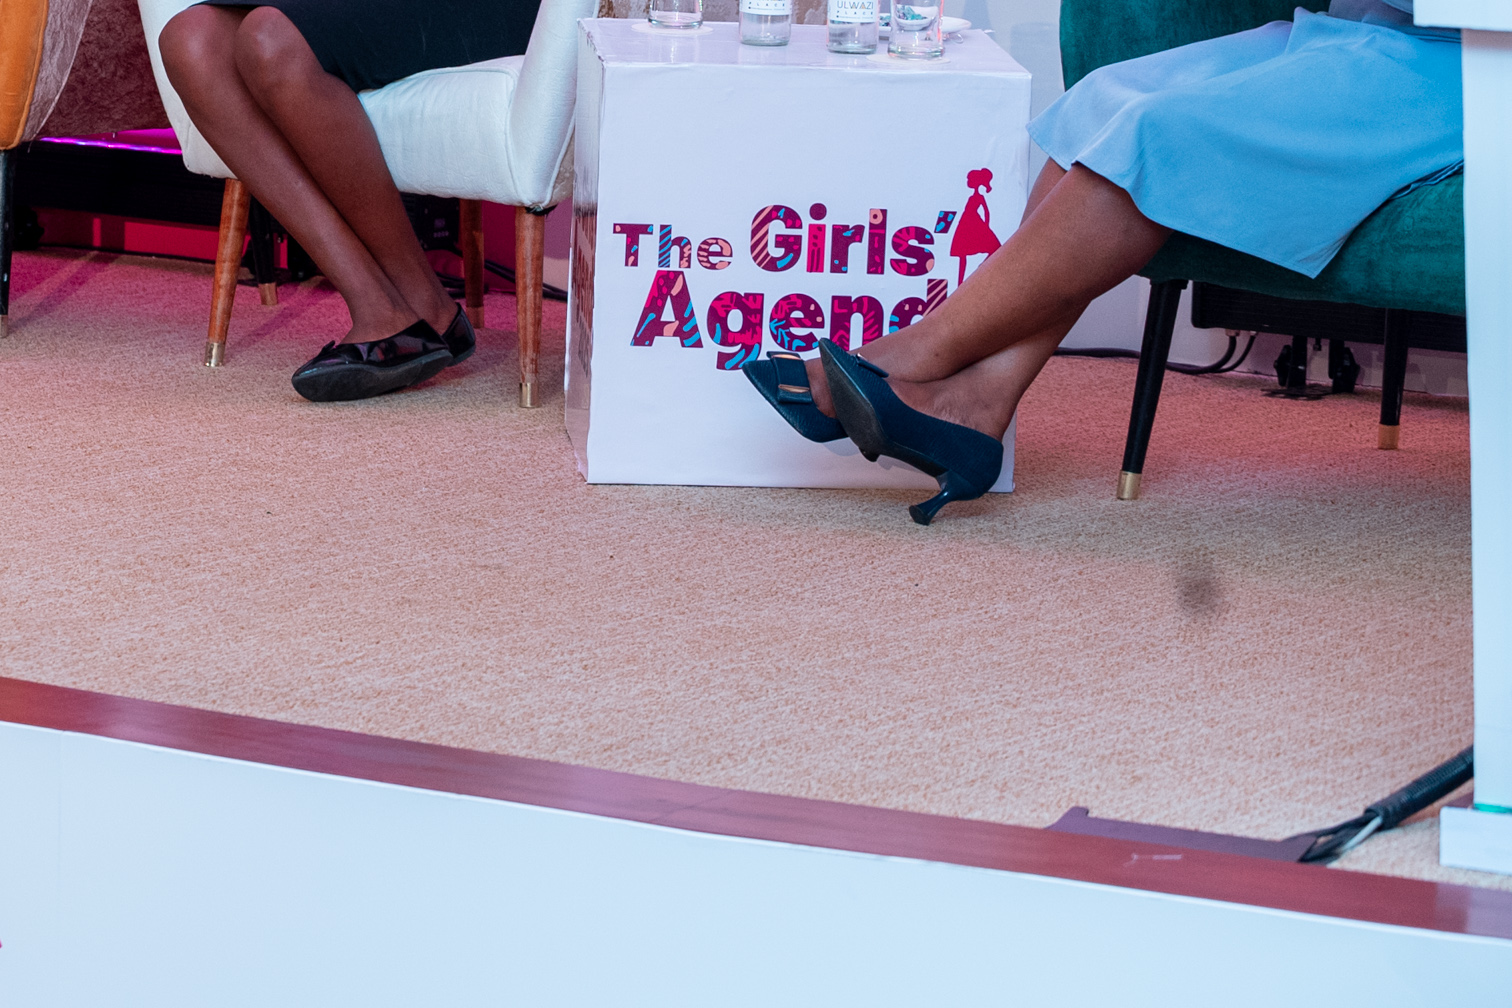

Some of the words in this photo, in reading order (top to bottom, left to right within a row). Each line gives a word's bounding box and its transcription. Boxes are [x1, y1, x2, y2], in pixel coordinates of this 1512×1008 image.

[837, 0, 874, 10] ULWAZI
[612, 222, 733, 270] The
[749, 202, 957, 277] Girls'
